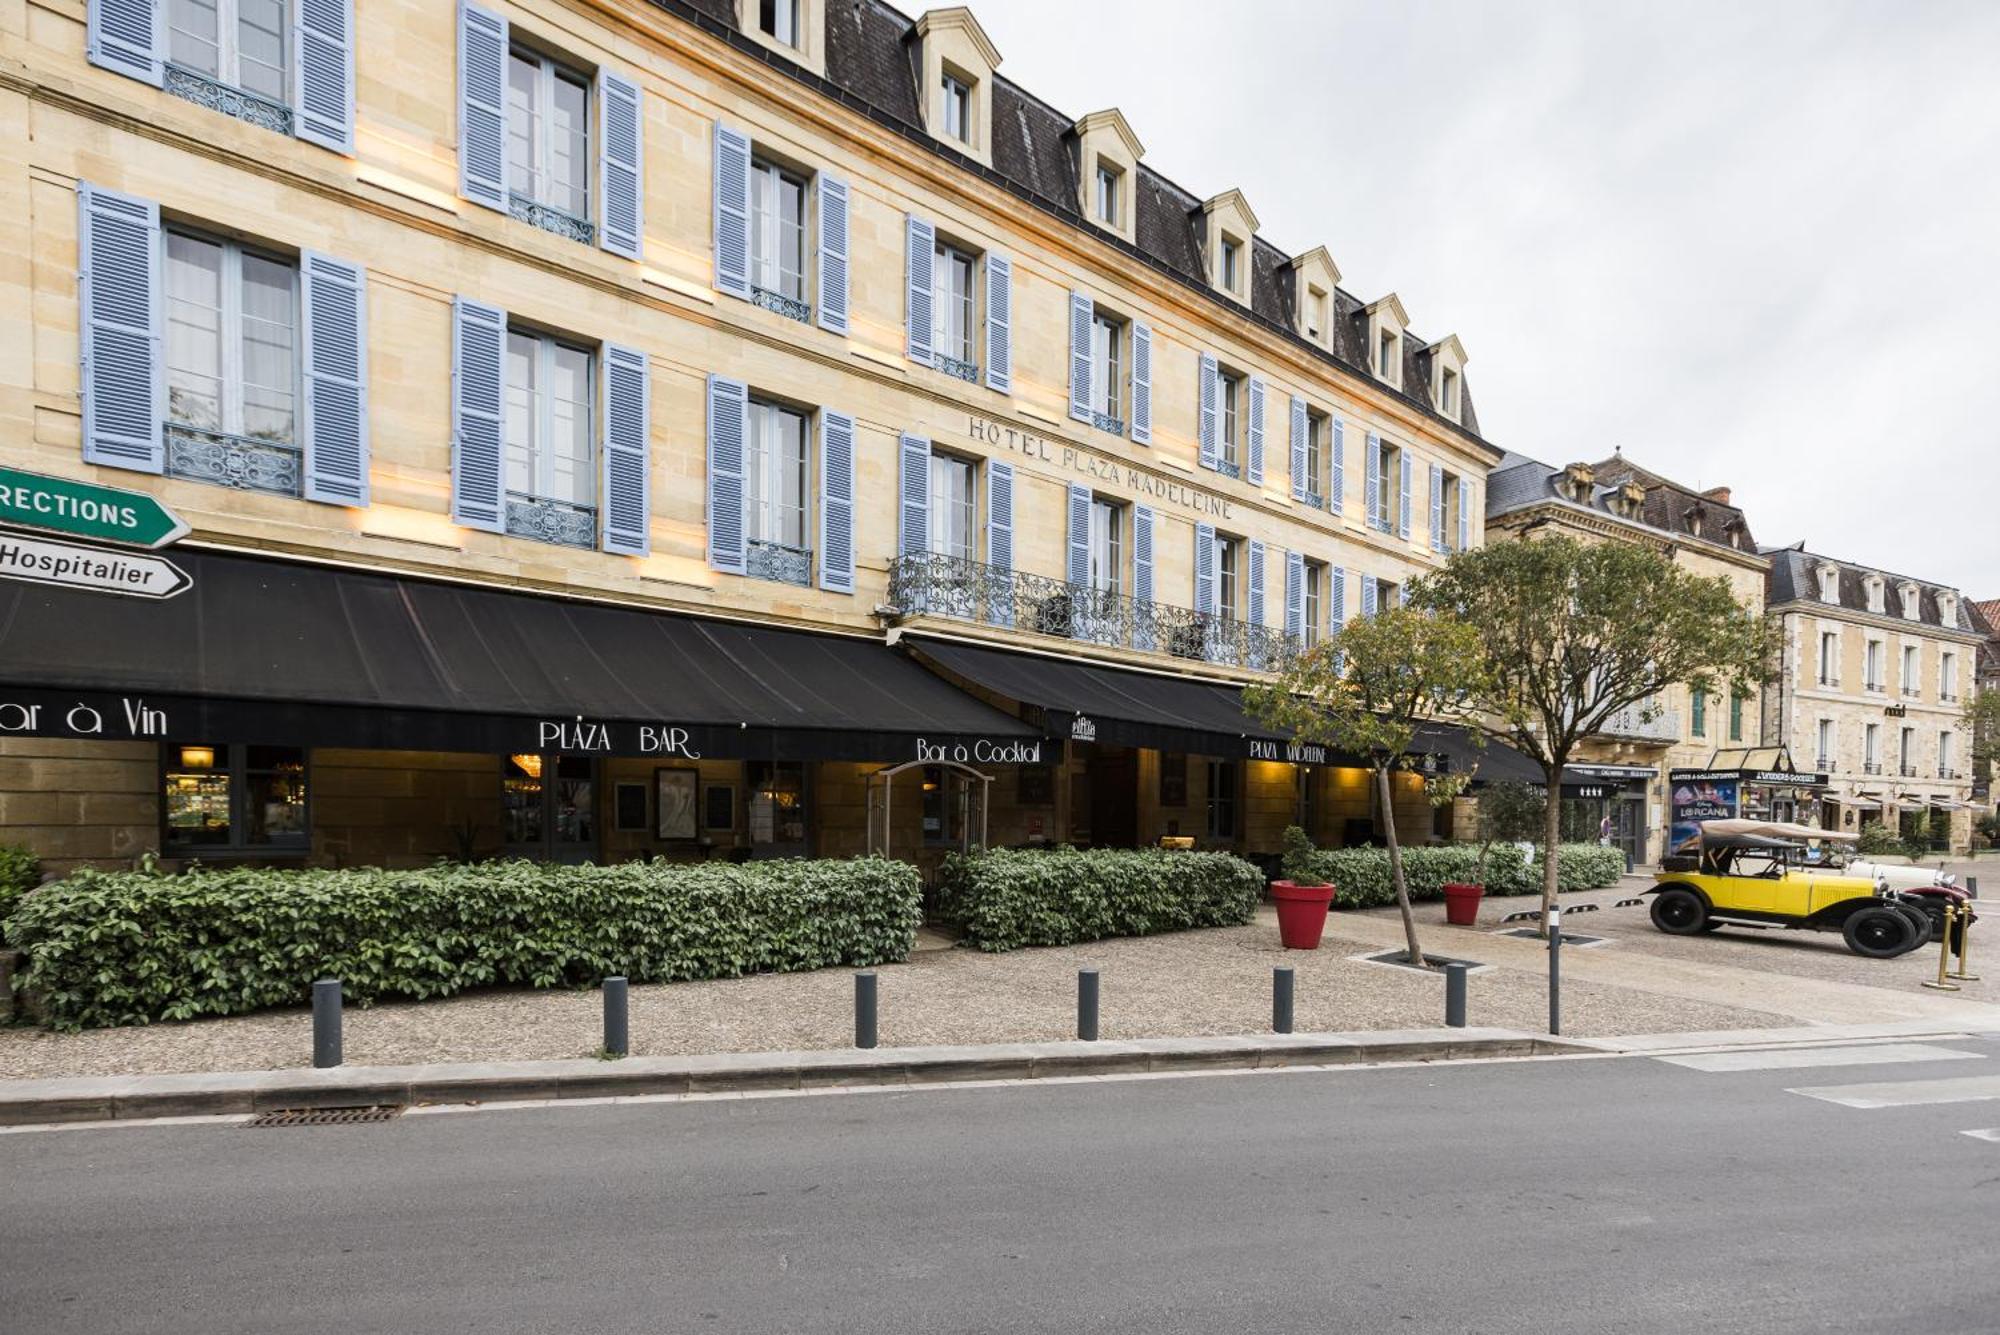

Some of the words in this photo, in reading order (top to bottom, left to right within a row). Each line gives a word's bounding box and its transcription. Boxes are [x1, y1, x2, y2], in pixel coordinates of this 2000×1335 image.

[968, 416, 1052, 463] HOTEL
[1063, 447, 1121, 485] PLAZA
[1127, 470, 1233, 521] MADELEINE
[0, 544, 153, 585] Hospitalier
[66, 702, 102, 733] à
[122, 698, 167, 735] Vin
[539, 721, 611, 751] PLAZA
[640, 726, 701, 760] BAR
[916, 738, 947, 762] Bar
[953, 744, 968, 763] à
[974, 739, 1040, 763] Cocktail
[1250, 740, 1277, 760] PLAZA
[1680, 807, 1729, 818] LORCANA
